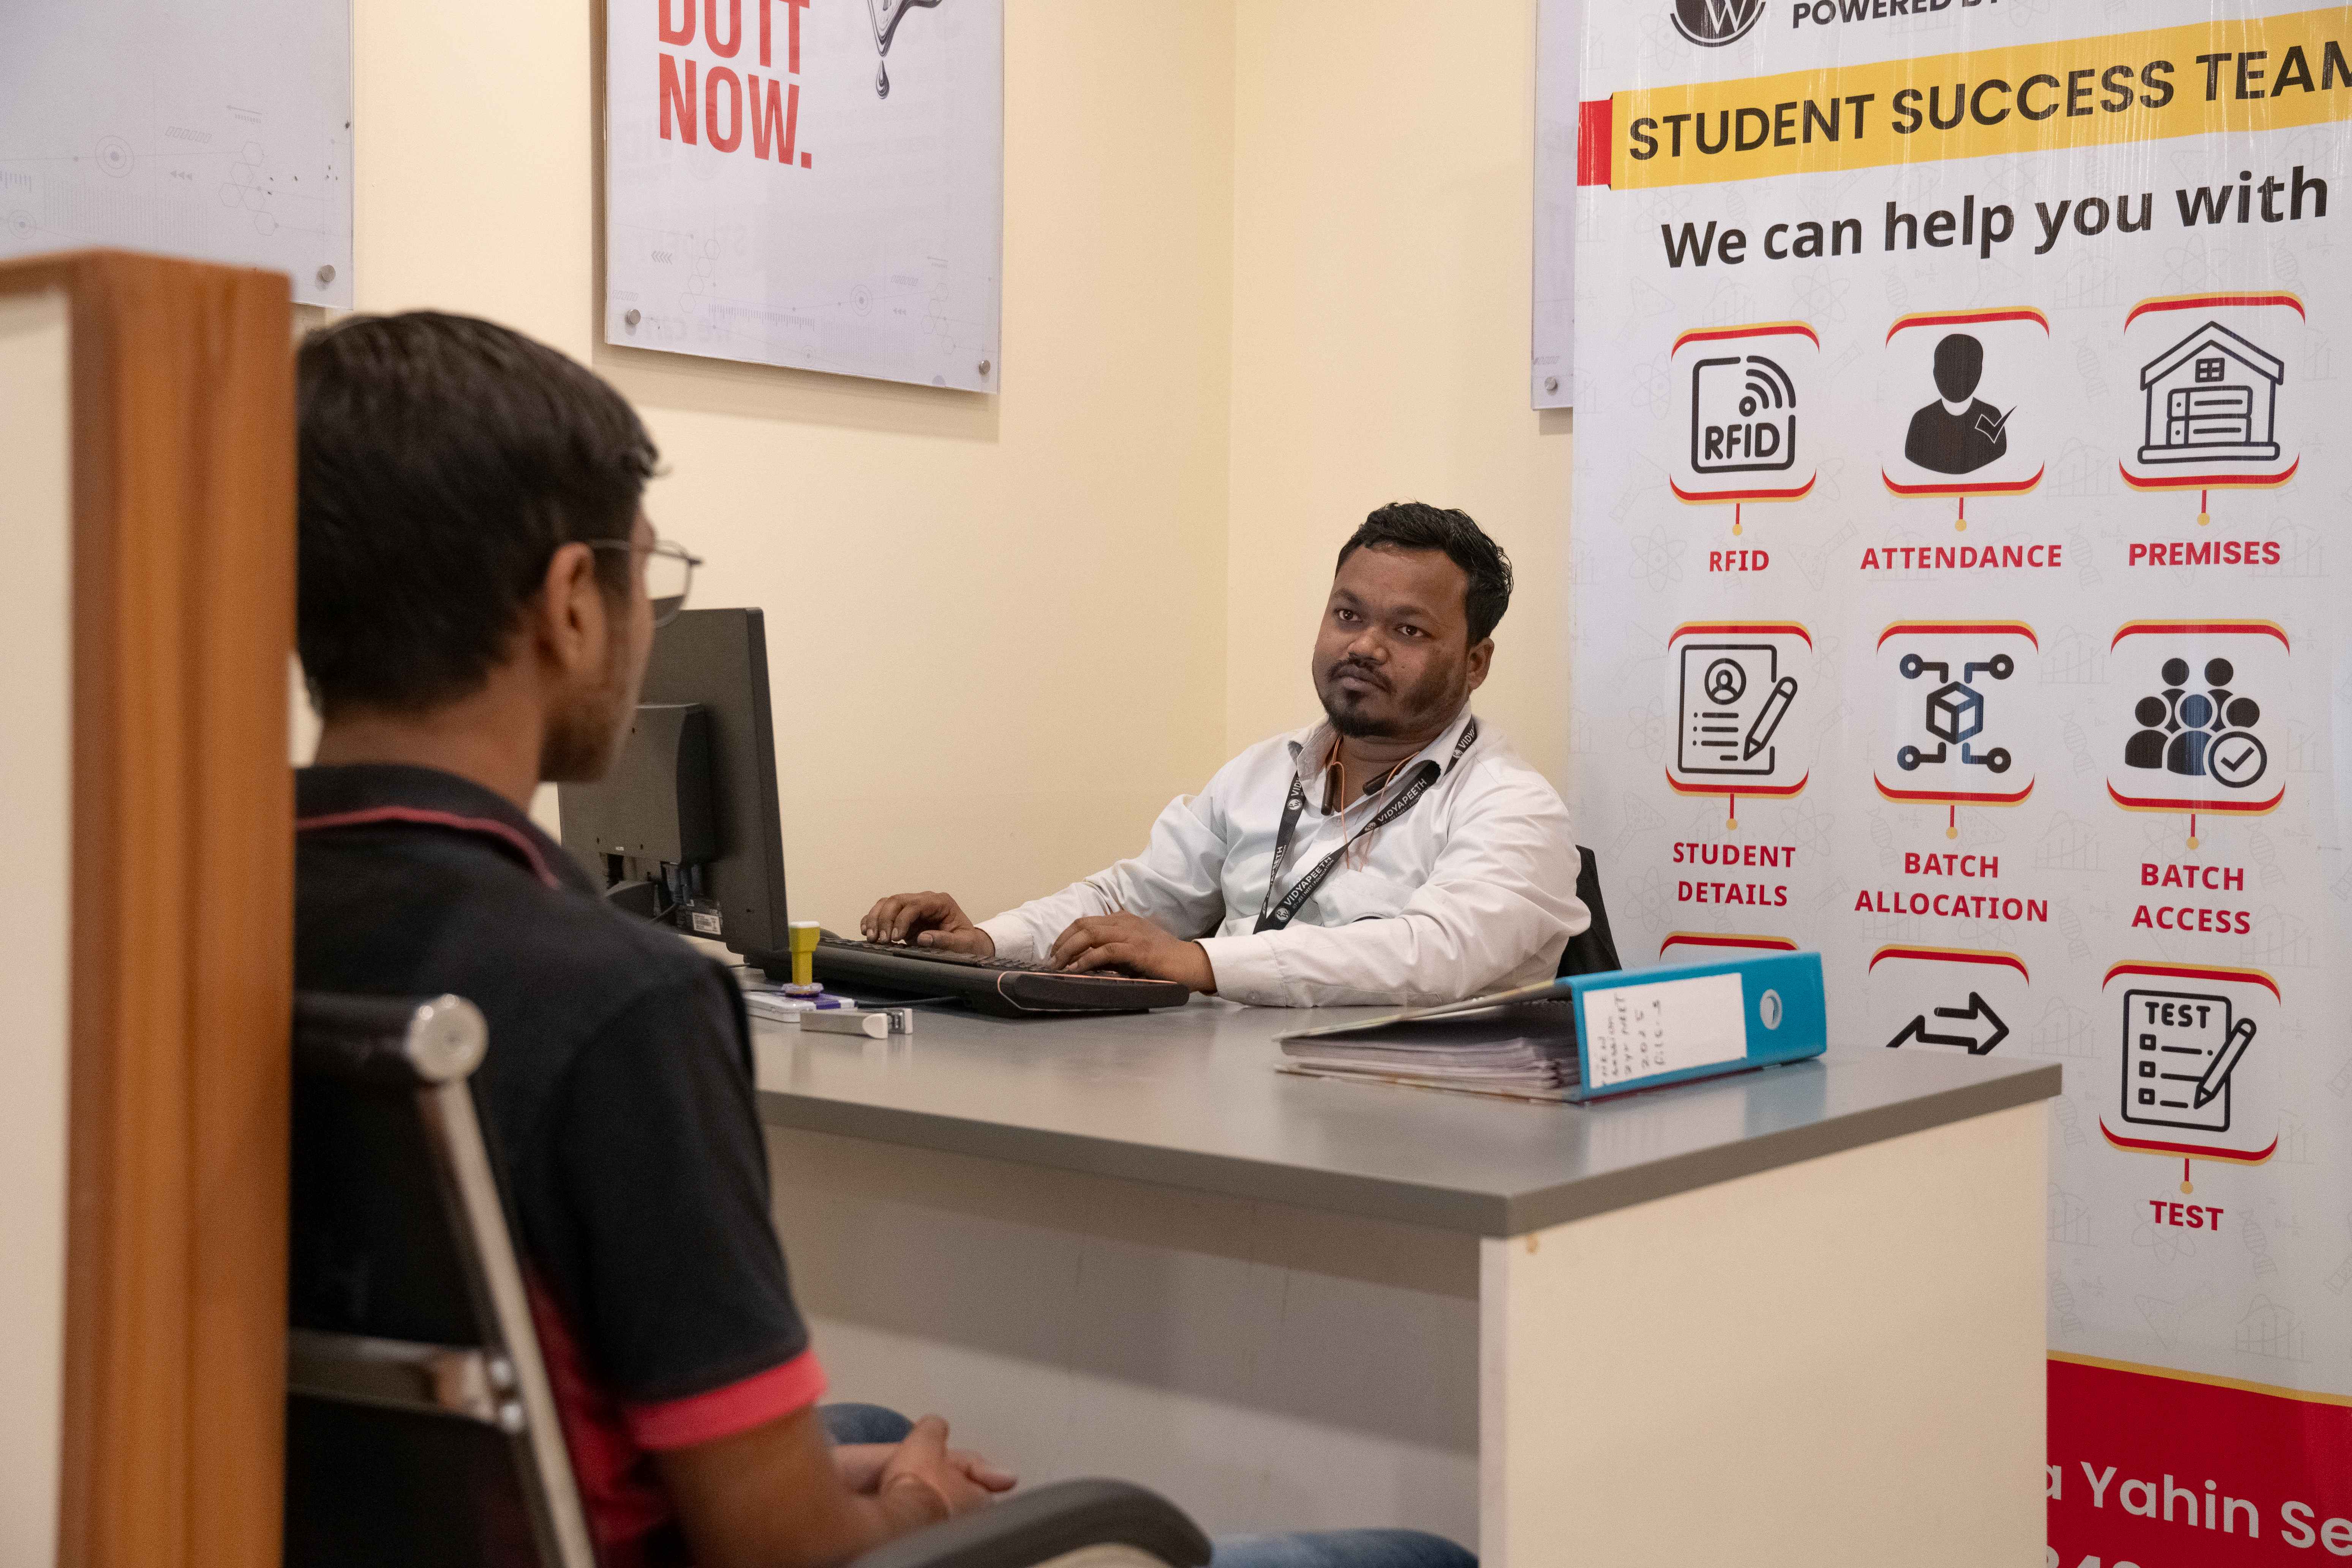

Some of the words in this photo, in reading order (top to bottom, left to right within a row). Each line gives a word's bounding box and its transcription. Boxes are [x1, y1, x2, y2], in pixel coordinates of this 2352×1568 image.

[760, 0, 810, 74] IT
[659, 53, 812, 169] NOW.
[1630, 93, 1875, 160] STUDENT
[1892, 60, 2175, 134] SUCCESS
[1661, 220, 1747, 268] We
[1764, 218, 1862, 260] can
[1884, 194, 2014, 259] help
[2034, 192, 2153, 255] you
[2175, 165, 2328, 227] with
[1705, 422, 1780, 460] RFID
[1709, 549, 1769, 573] RFID
[1860, 544, 2063, 571] ATTENDANCE
[2128, 540, 2281, 567] PREMISES
[1377, 778, 1427, 822] VIDYAPEETH
[1672, 841, 1796, 869] STUDENT
[1904, 852, 1999, 879] BATCH
[1283, 857, 1332, 906] VIDYAPEETH
[1314, 860, 1334, 884] FOUNDATION
[2140, 862, 2244, 891] BATCH
[1678, 880, 1788, 907] DETAILS
[1854, 889, 2049, 923] ALLOCATION
[2131, 904, 2251, 935] ACCESS
[2145, 1001, 2211, 1029] TEST
[2149, 1200, 2224, 1231] TEST
[2080, 1461, 2259, 1539] Yahin
[2281, 1500, 2352, 1557] Se
